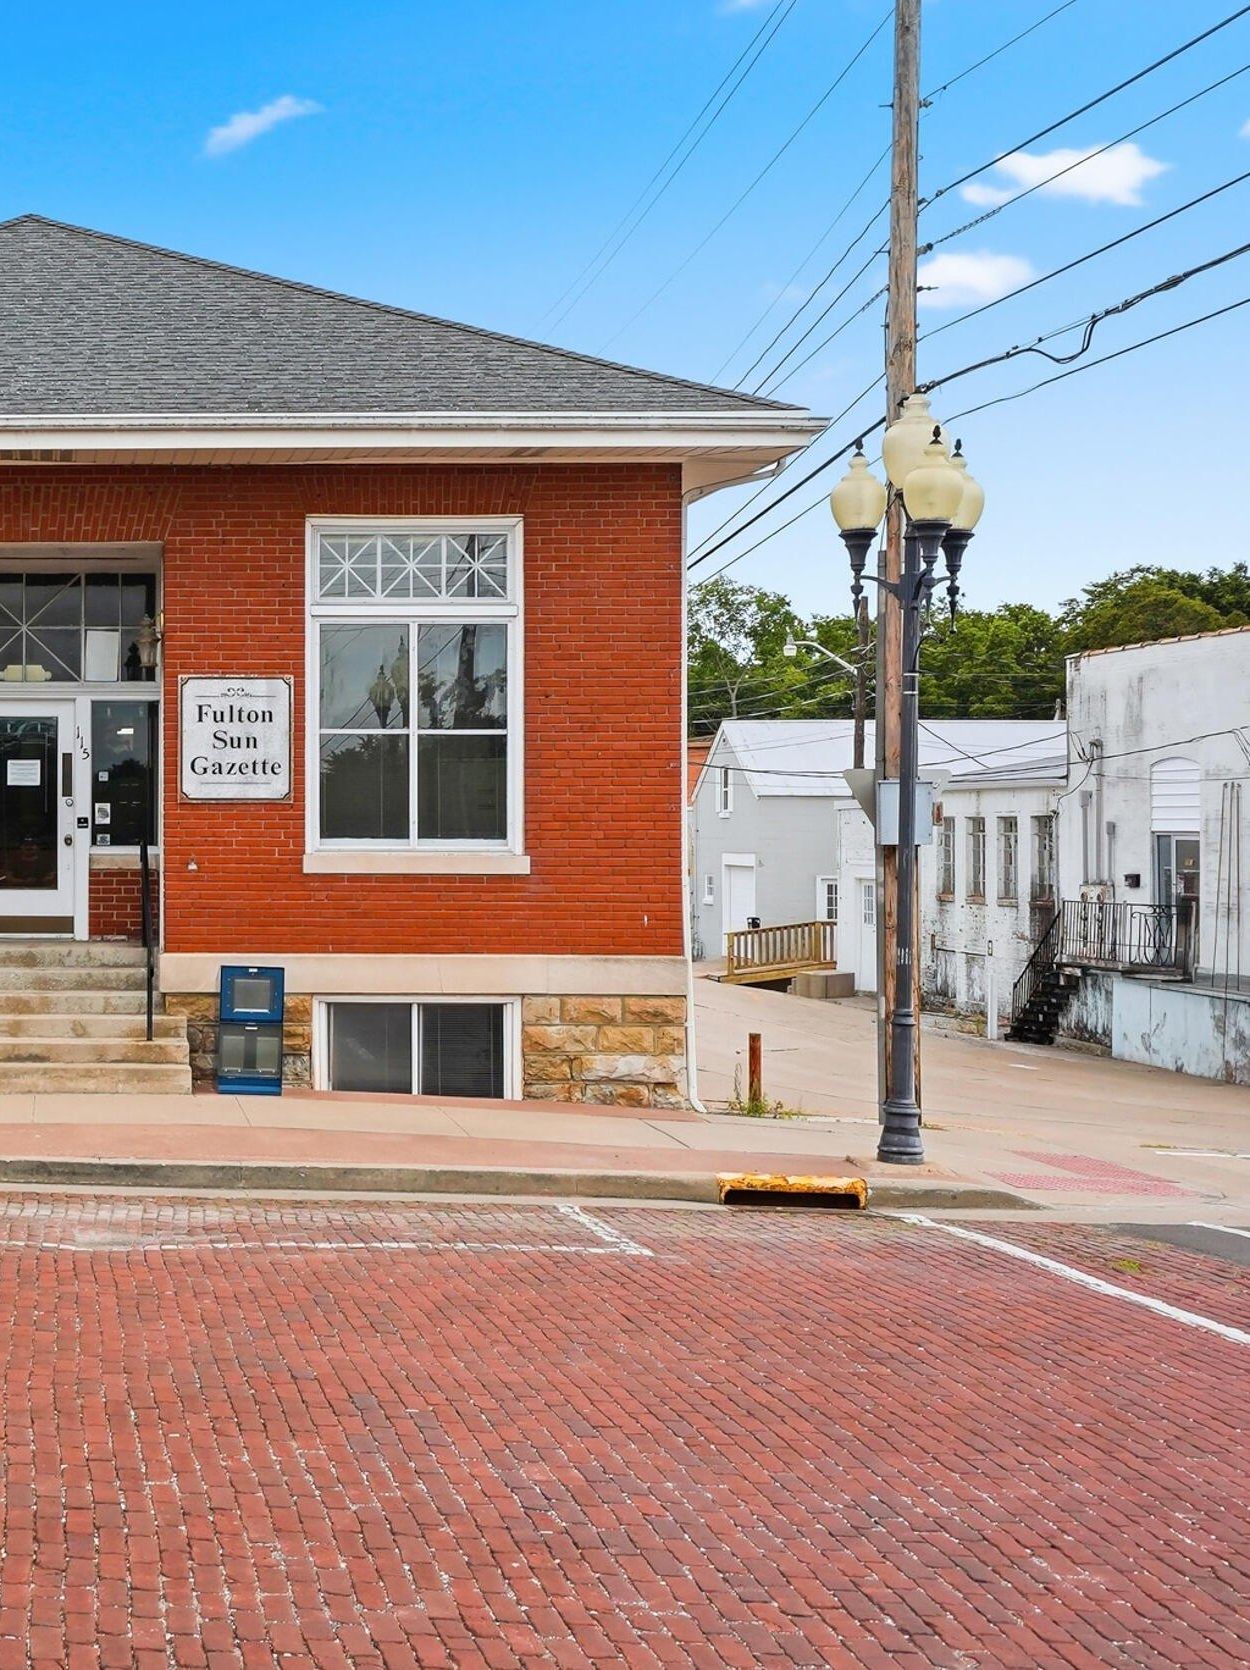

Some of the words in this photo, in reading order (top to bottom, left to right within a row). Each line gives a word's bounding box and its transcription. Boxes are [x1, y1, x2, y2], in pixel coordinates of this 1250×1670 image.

[196, 703, 274, 723] Fulton
[76, 725, 90, 760] 115
[212, 730, 259, 749] Sun
[190, 756, 283, 775] Gazette
